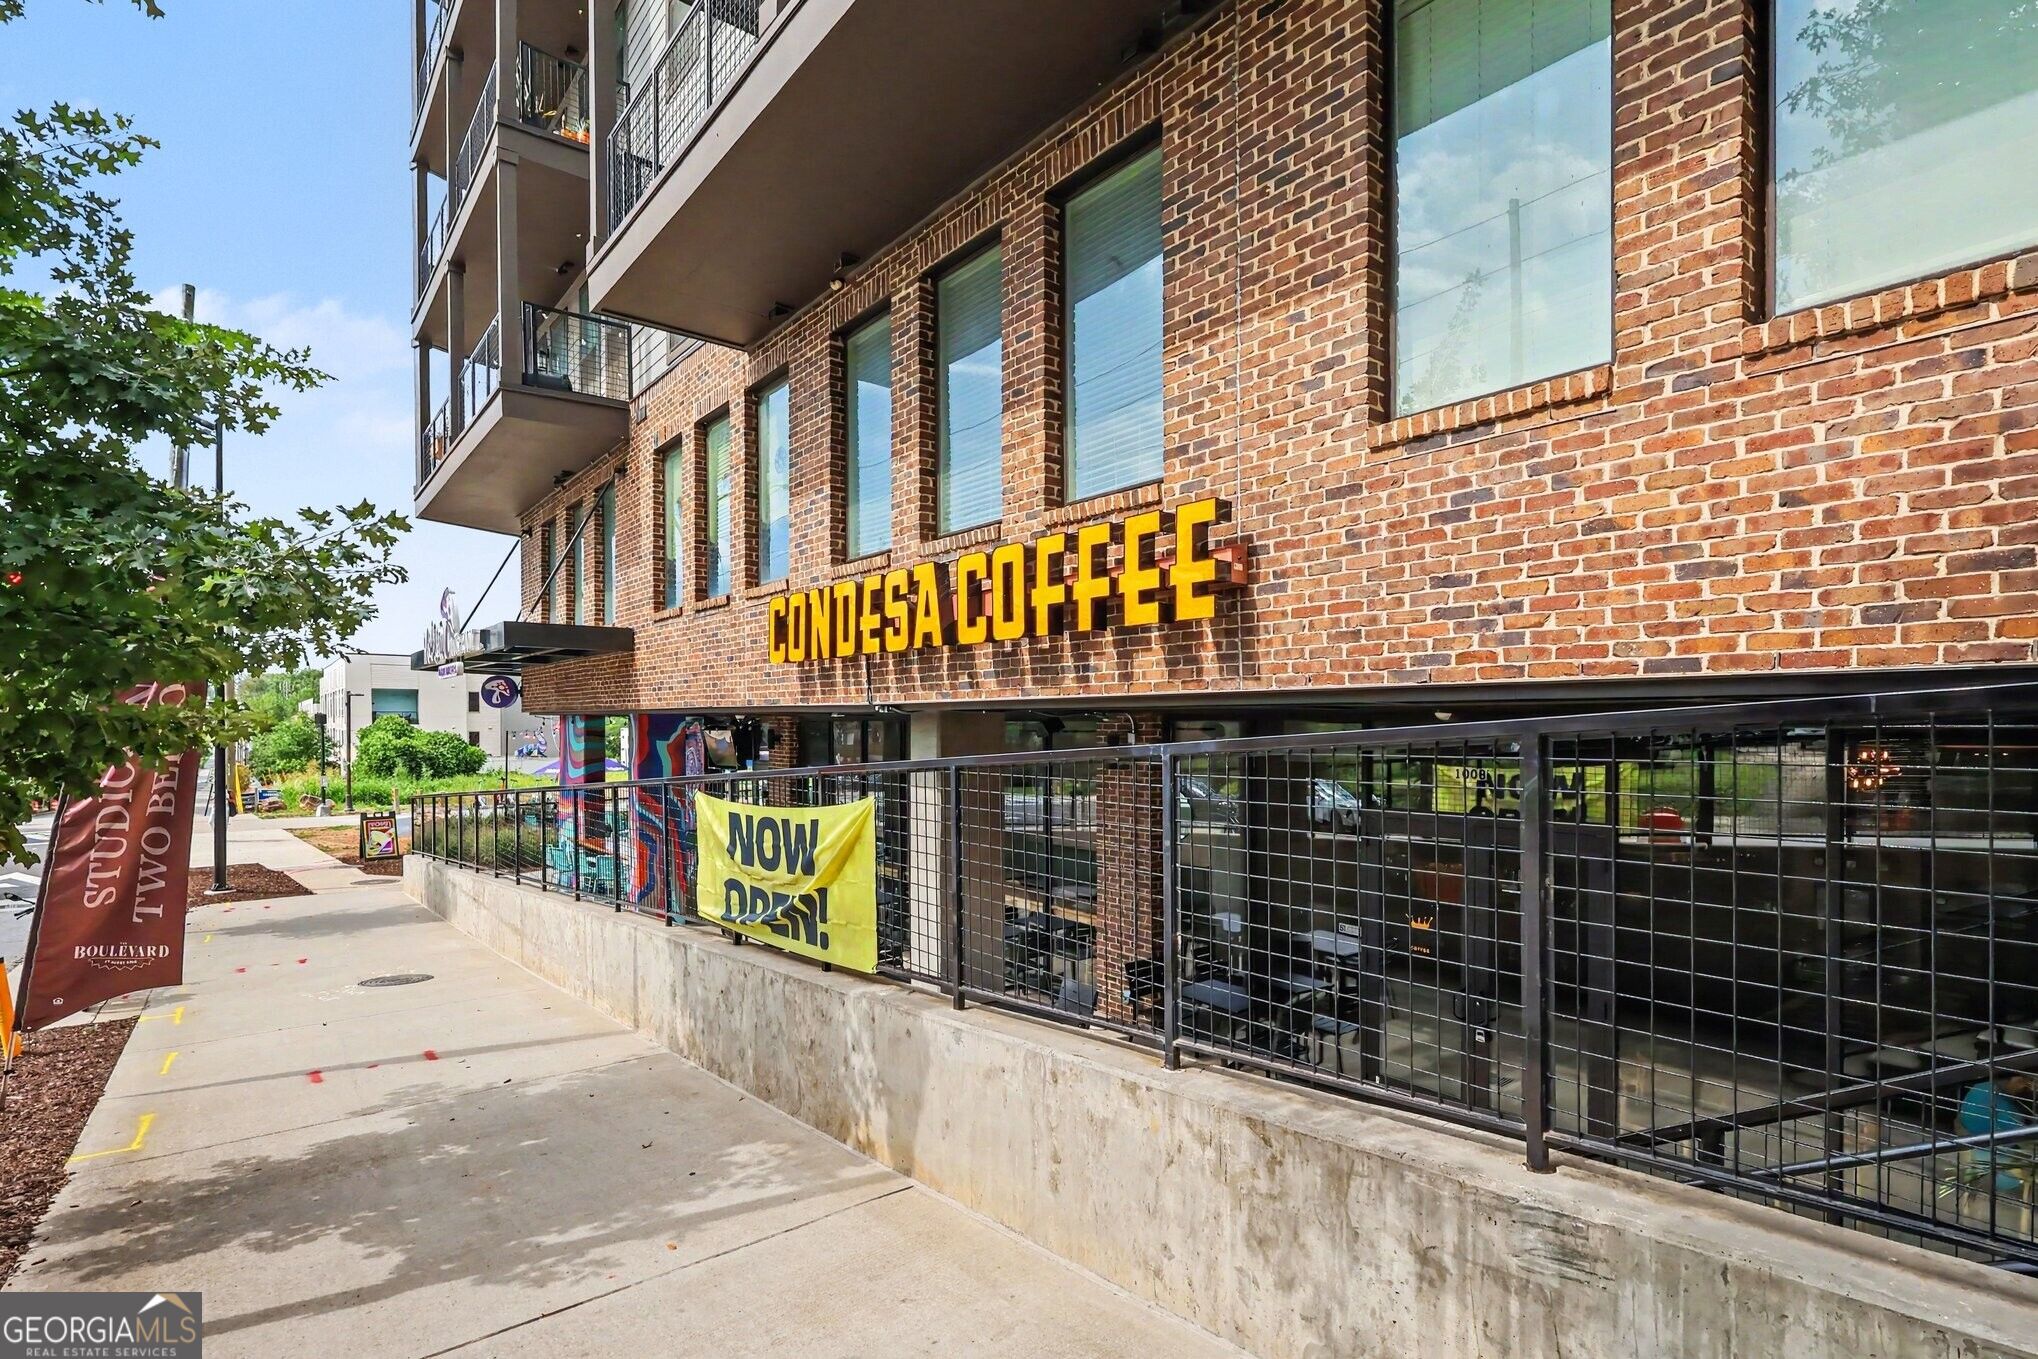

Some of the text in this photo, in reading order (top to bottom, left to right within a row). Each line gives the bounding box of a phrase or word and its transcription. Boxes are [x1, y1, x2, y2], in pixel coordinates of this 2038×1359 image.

[768, 498, 1219, 665] CONDESA COFFEE
[1455, 768, 1486, 780] 1008
[132, 826, 171, 923] TWO
[726, 811, 819, 877] NOW
[720, 877, 830, 951] OPEN!
